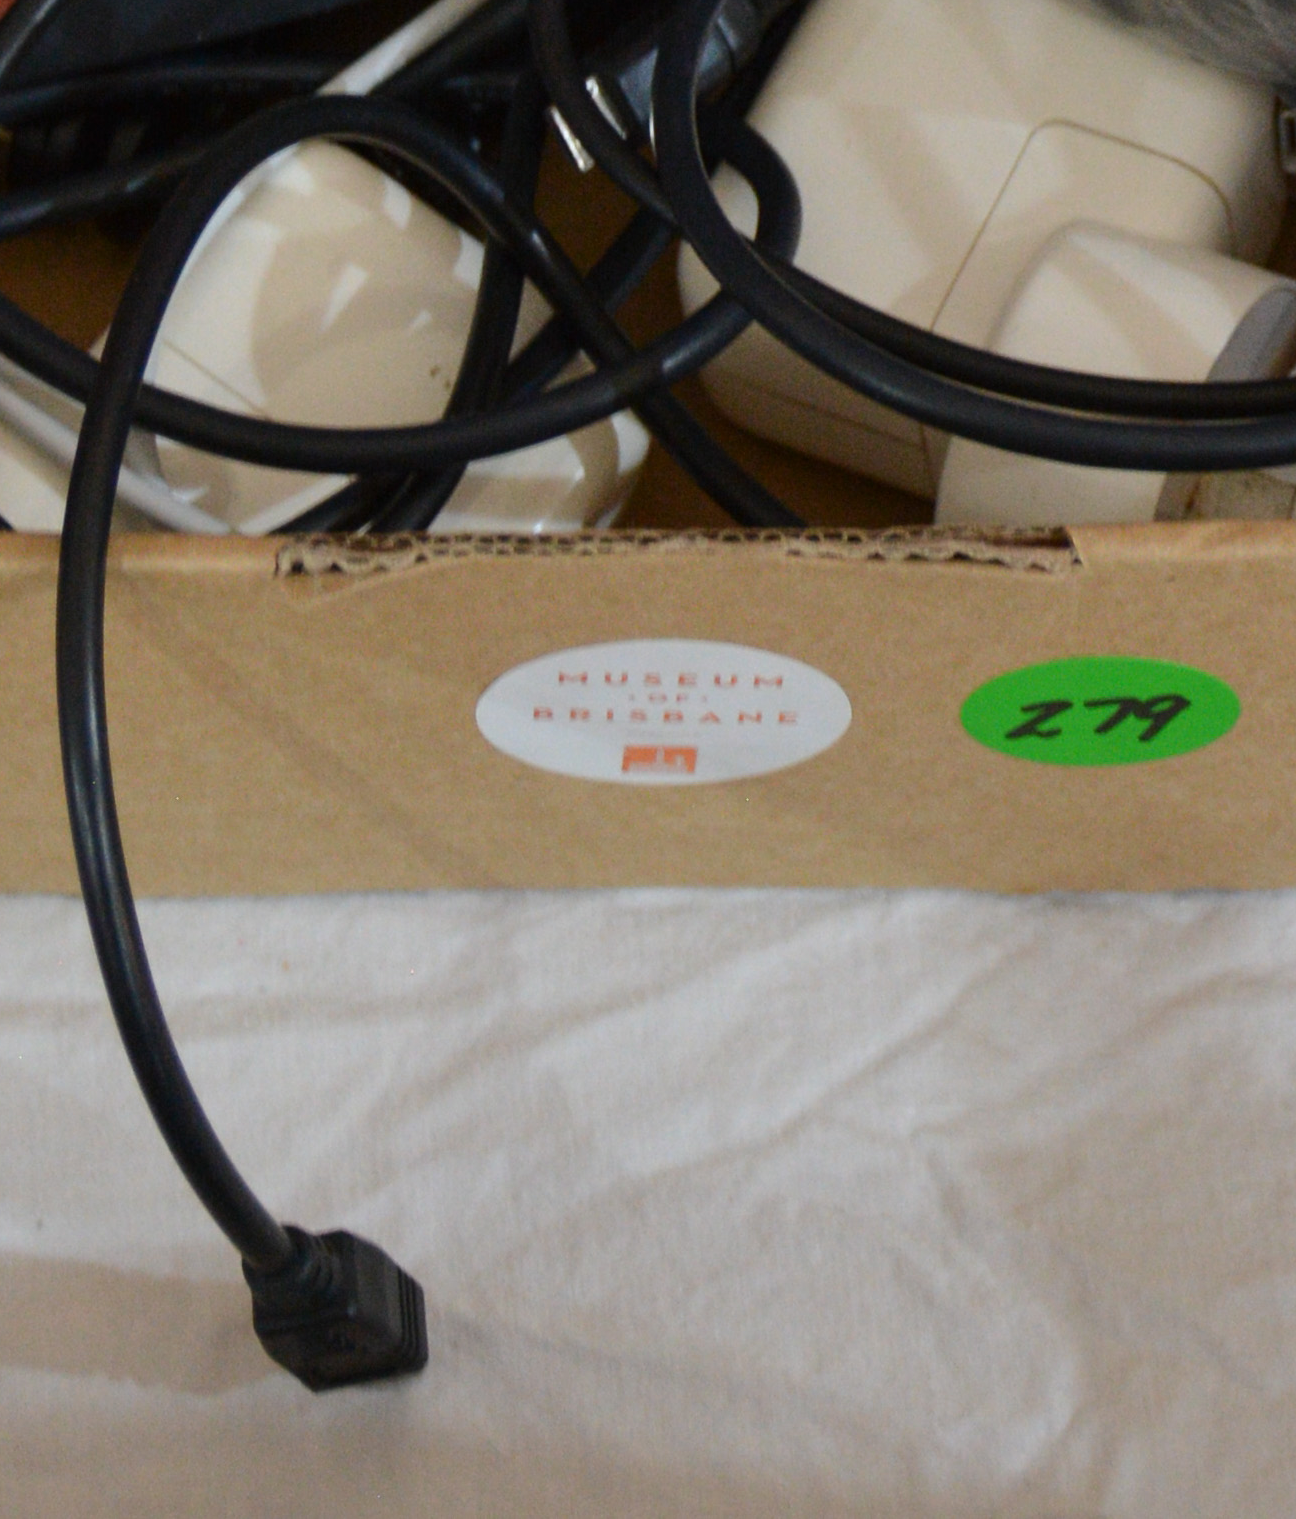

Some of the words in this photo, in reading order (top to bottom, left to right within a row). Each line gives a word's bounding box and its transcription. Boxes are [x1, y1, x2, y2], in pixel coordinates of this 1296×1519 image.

[557, 670, 784, 689] MUSEUM
[532, 706, 800, 725] BRISBANE
[1004, 693, 1192, 743] 279
